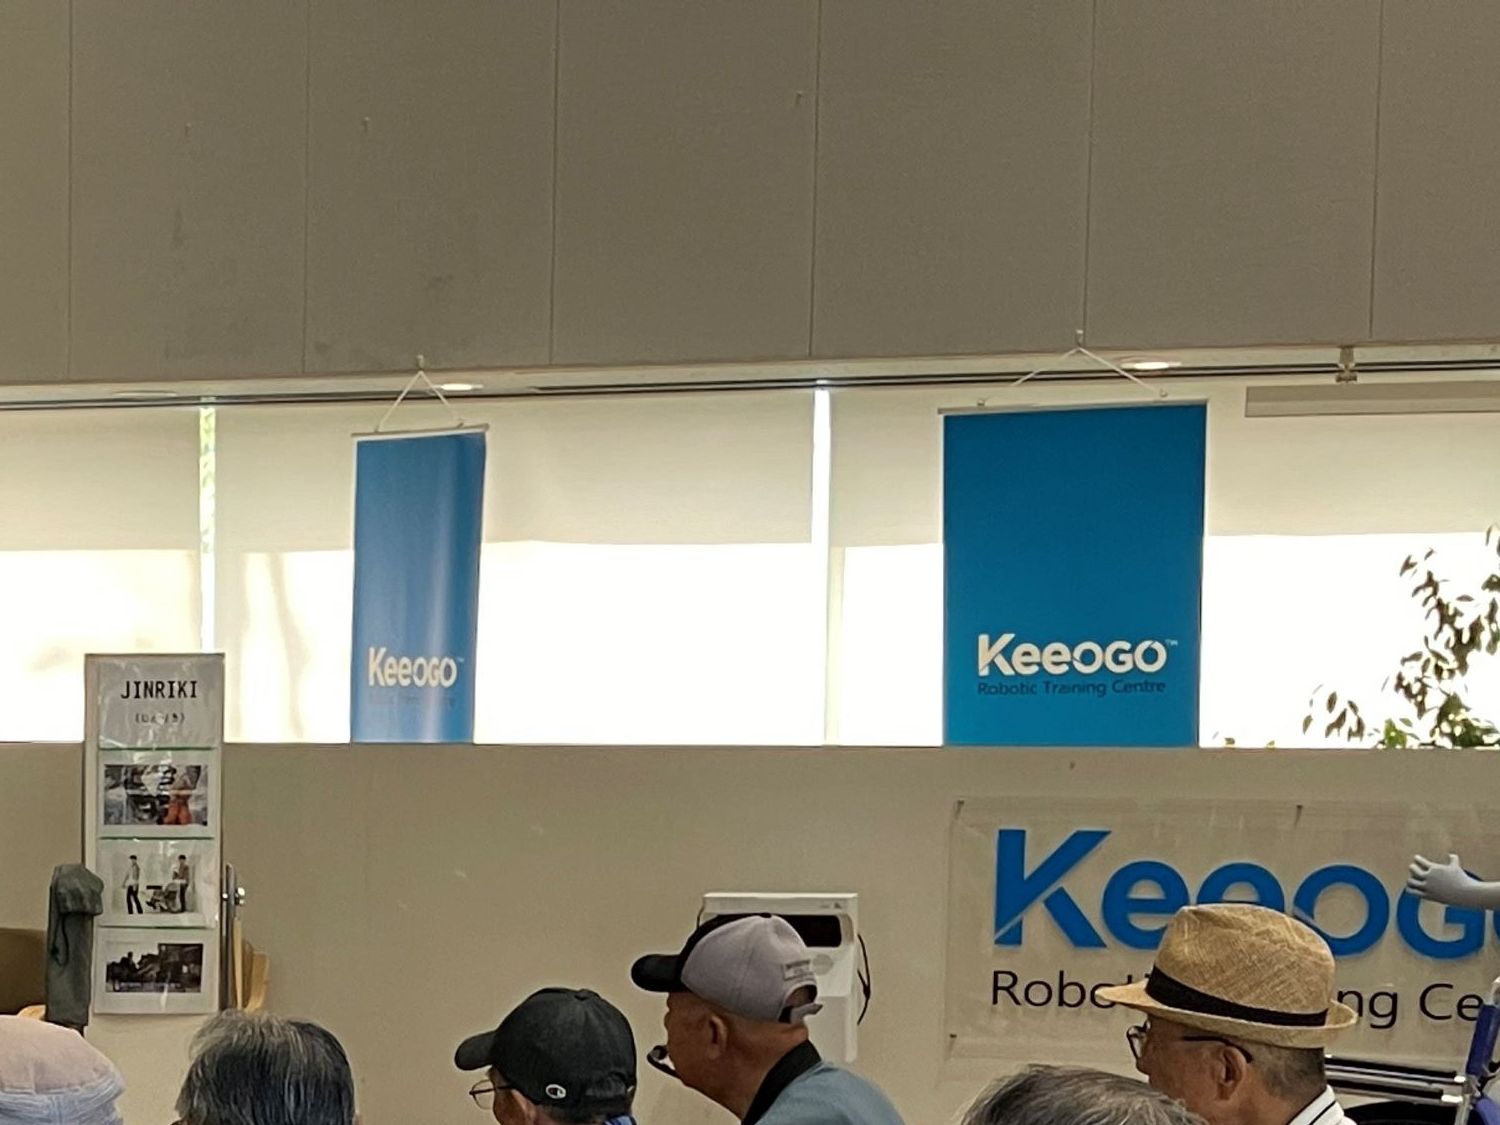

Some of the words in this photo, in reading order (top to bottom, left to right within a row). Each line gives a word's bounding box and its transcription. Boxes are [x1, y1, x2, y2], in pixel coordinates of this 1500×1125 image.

[120, 680, 198, 699] JINRIKI
[978, 680, 1038, 696] Robotic
[1043, 680, 1107, 698] Training
[1112, 679, 1167, 695] Centre
[992, 970, 1150, 1008] Robo
